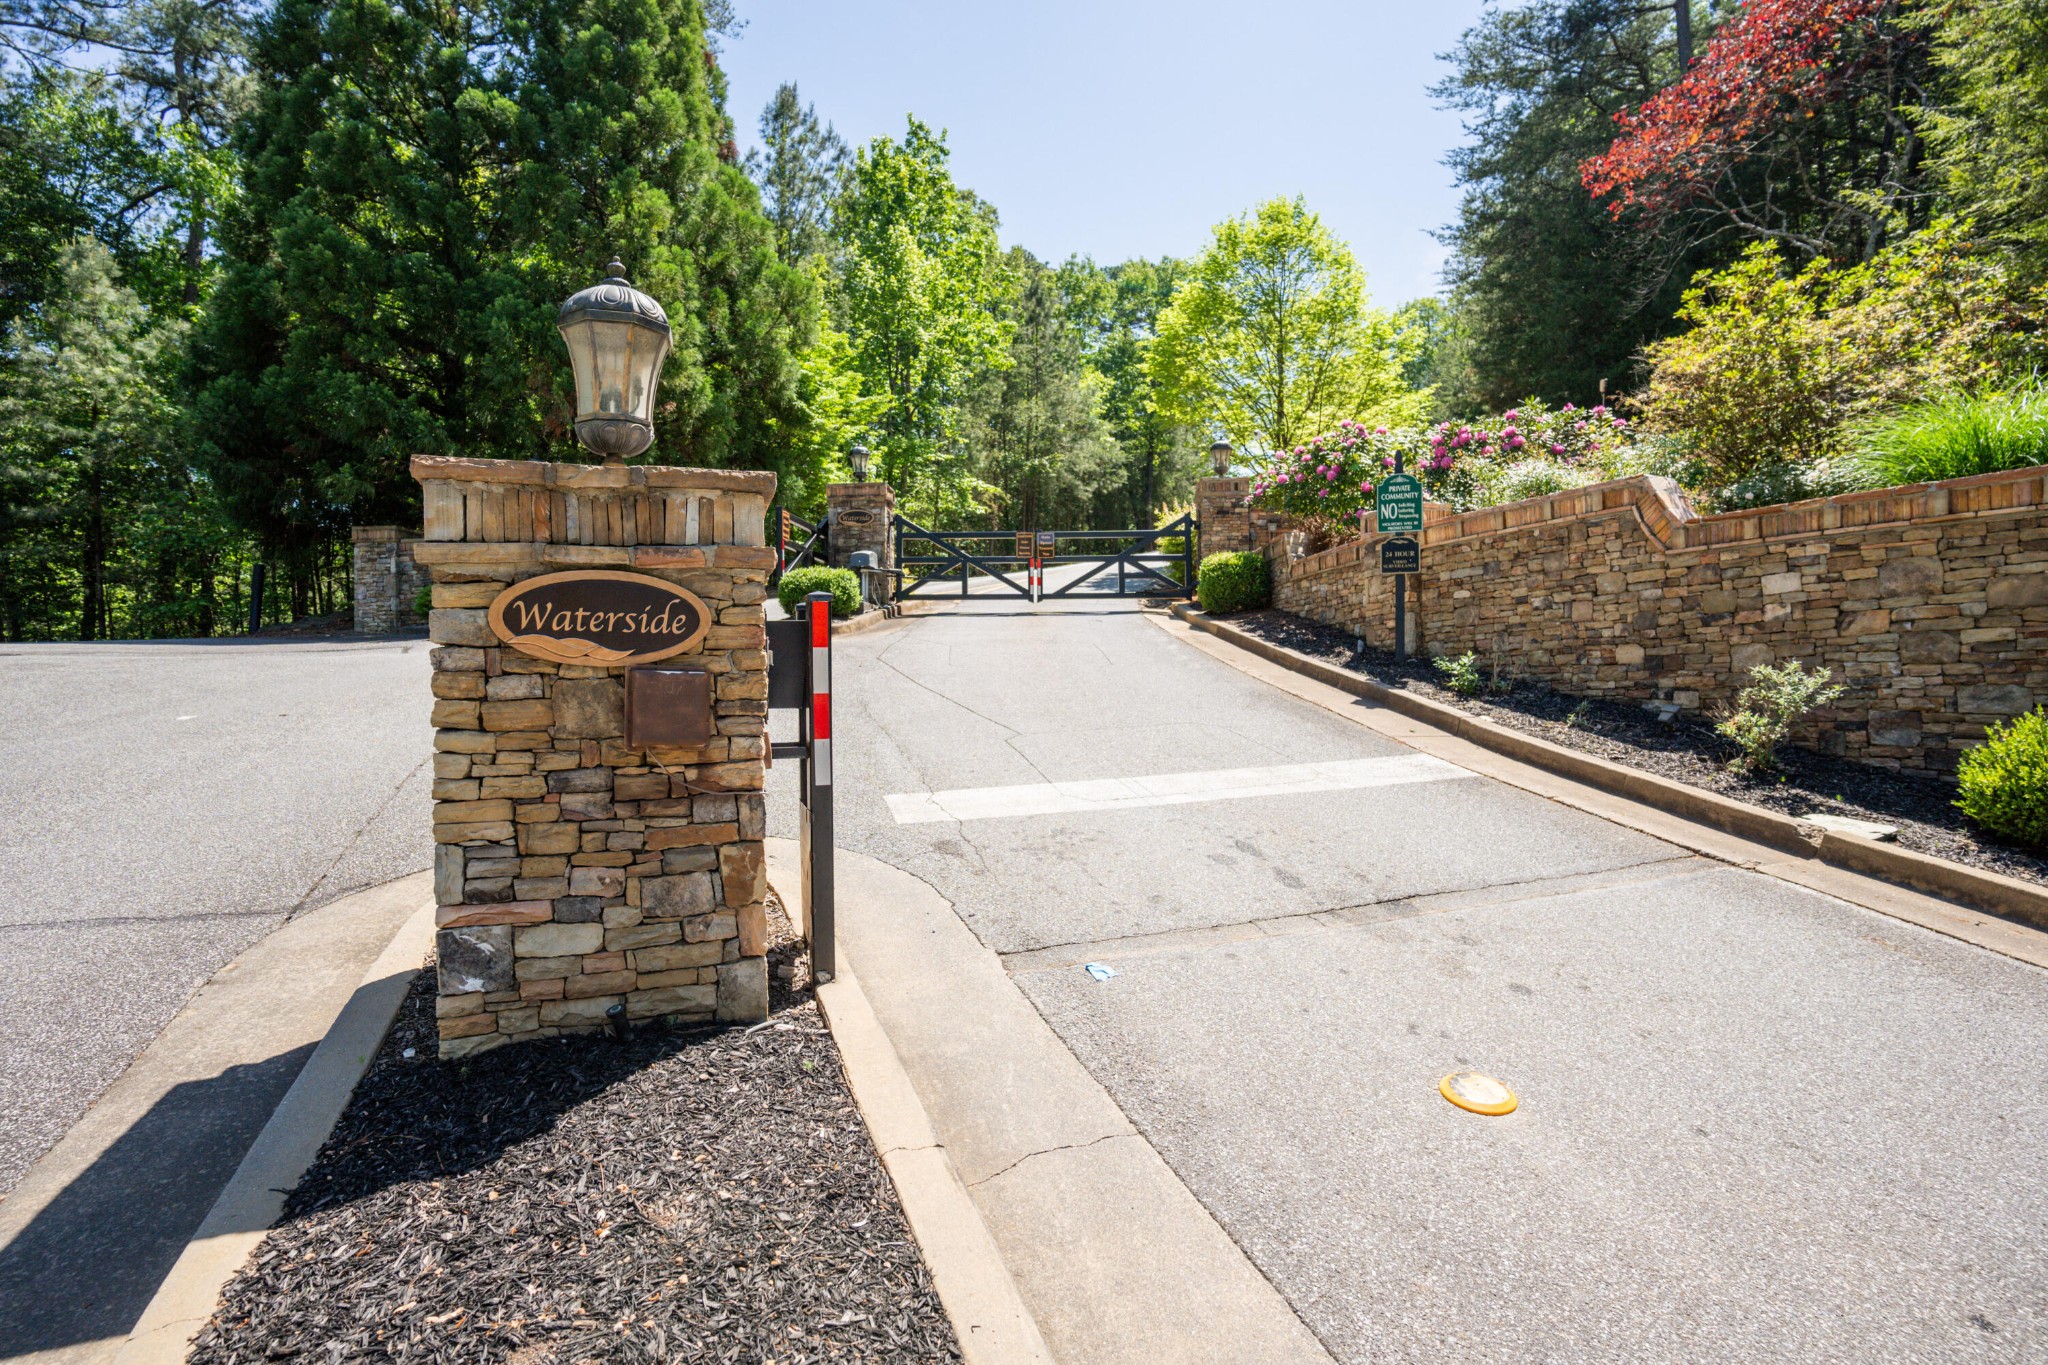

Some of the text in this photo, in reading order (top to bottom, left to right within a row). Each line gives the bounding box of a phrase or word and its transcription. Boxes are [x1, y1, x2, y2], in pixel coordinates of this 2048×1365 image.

[1381, 492, 1418, 500] COMMUNITY
[1381, 503, 1398, 519] NO
[513, 599, 686, 634] Waterside
